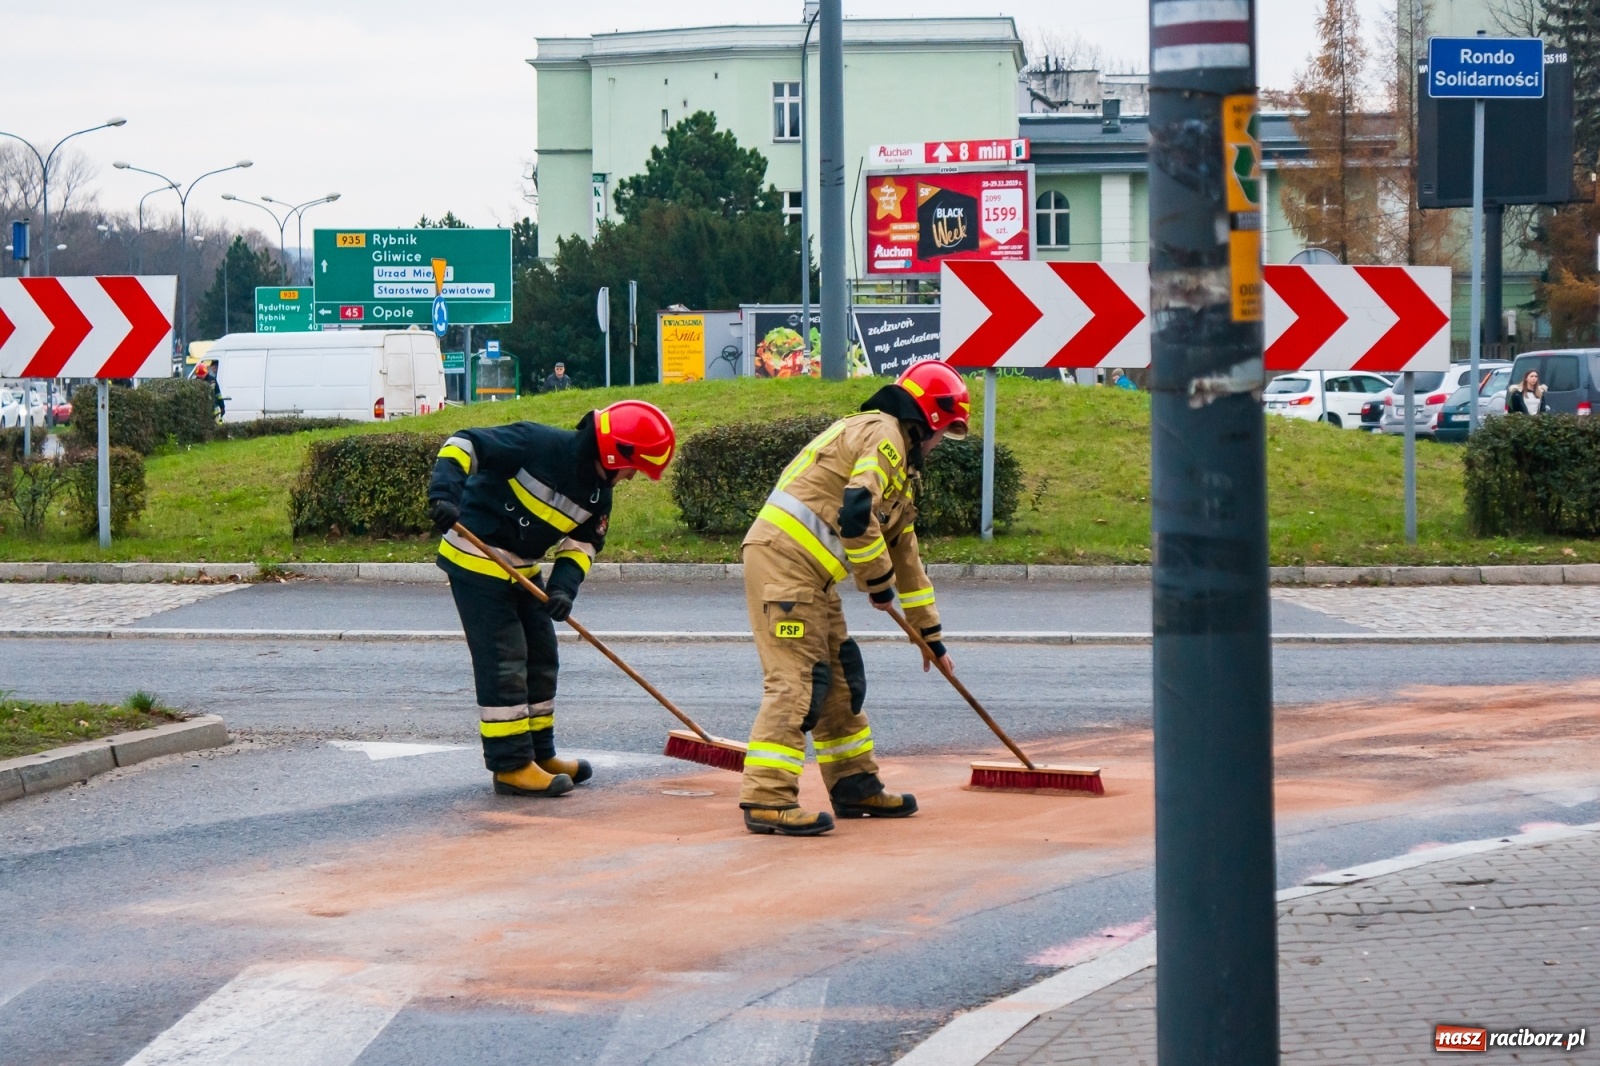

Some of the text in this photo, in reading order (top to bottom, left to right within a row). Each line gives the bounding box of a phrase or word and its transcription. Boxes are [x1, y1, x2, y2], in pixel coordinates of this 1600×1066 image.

[1460, 49, 1515, 64] Rondo
[1435, 71, 1539, 87] Solidarności
[878, 146, 912, 157] Auchan
[959, 142, 1006, 160] 8 min
[936, 207, 964, 218] BLACK
[984, 207, 1017, 222] 1599
[932, 217, 968, 248] Week
[342, 234, 417, 248] 935 Rybnik
[372, 250, 421, 262] Gliwice
[874, 244, 912, 258] Auchan
[377, 269, 449, 279] Urząd Mieji
[377, 286, 491, 295] Starostwo owiatowe
[258, 303, 301, 312] Rydułtowy
[345, 306, 414, 320] 45 Opole
[258, 314, 286, 323] Rybnik
[259, 322, 276, 332] Żory
[867, 317, 915, 335] zadzwoń
[663, 328, 703, 341] Anita
[874, 332, 941, 353] my dowieziem
[881, 352, 940, 374] pod wskazan
[882, 443, 898, 460] PSP
[780, 625, 800, 635] PSP
